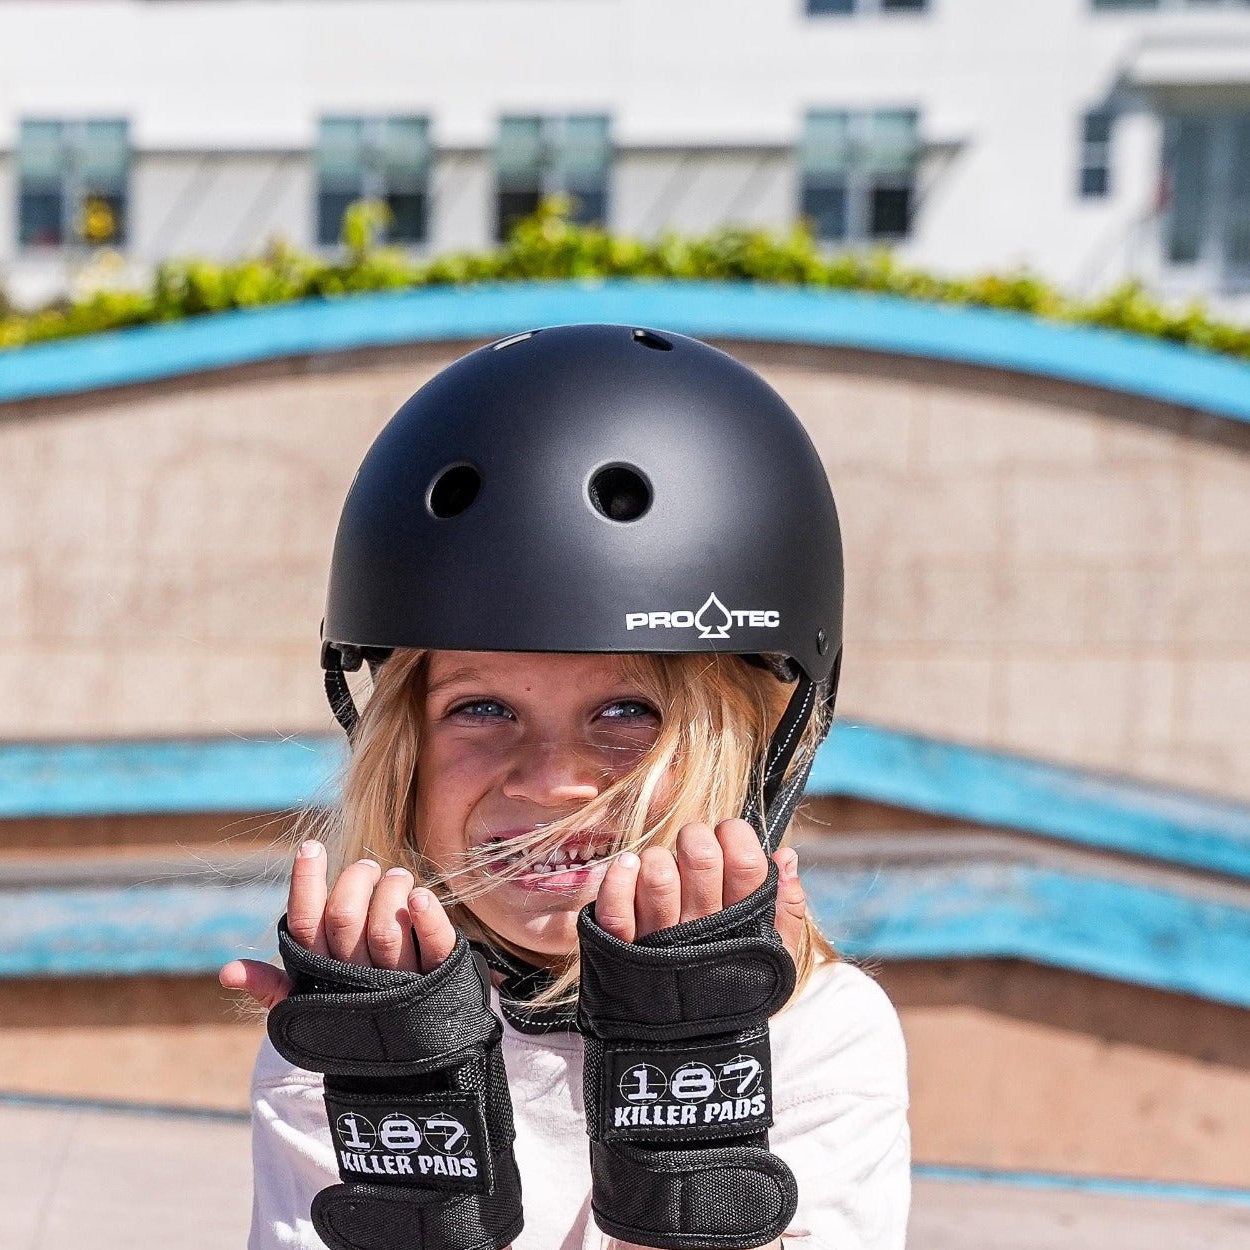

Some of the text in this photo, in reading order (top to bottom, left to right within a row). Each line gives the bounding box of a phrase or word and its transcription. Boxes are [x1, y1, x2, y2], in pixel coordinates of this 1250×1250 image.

[621, 1056, 761, 1103] 187
[614, 1094, 766, 1127] KILLER PADS
[338, 1113, 468, 1154] 187
[340, 1150, 478, 1178] KILLER PADS
